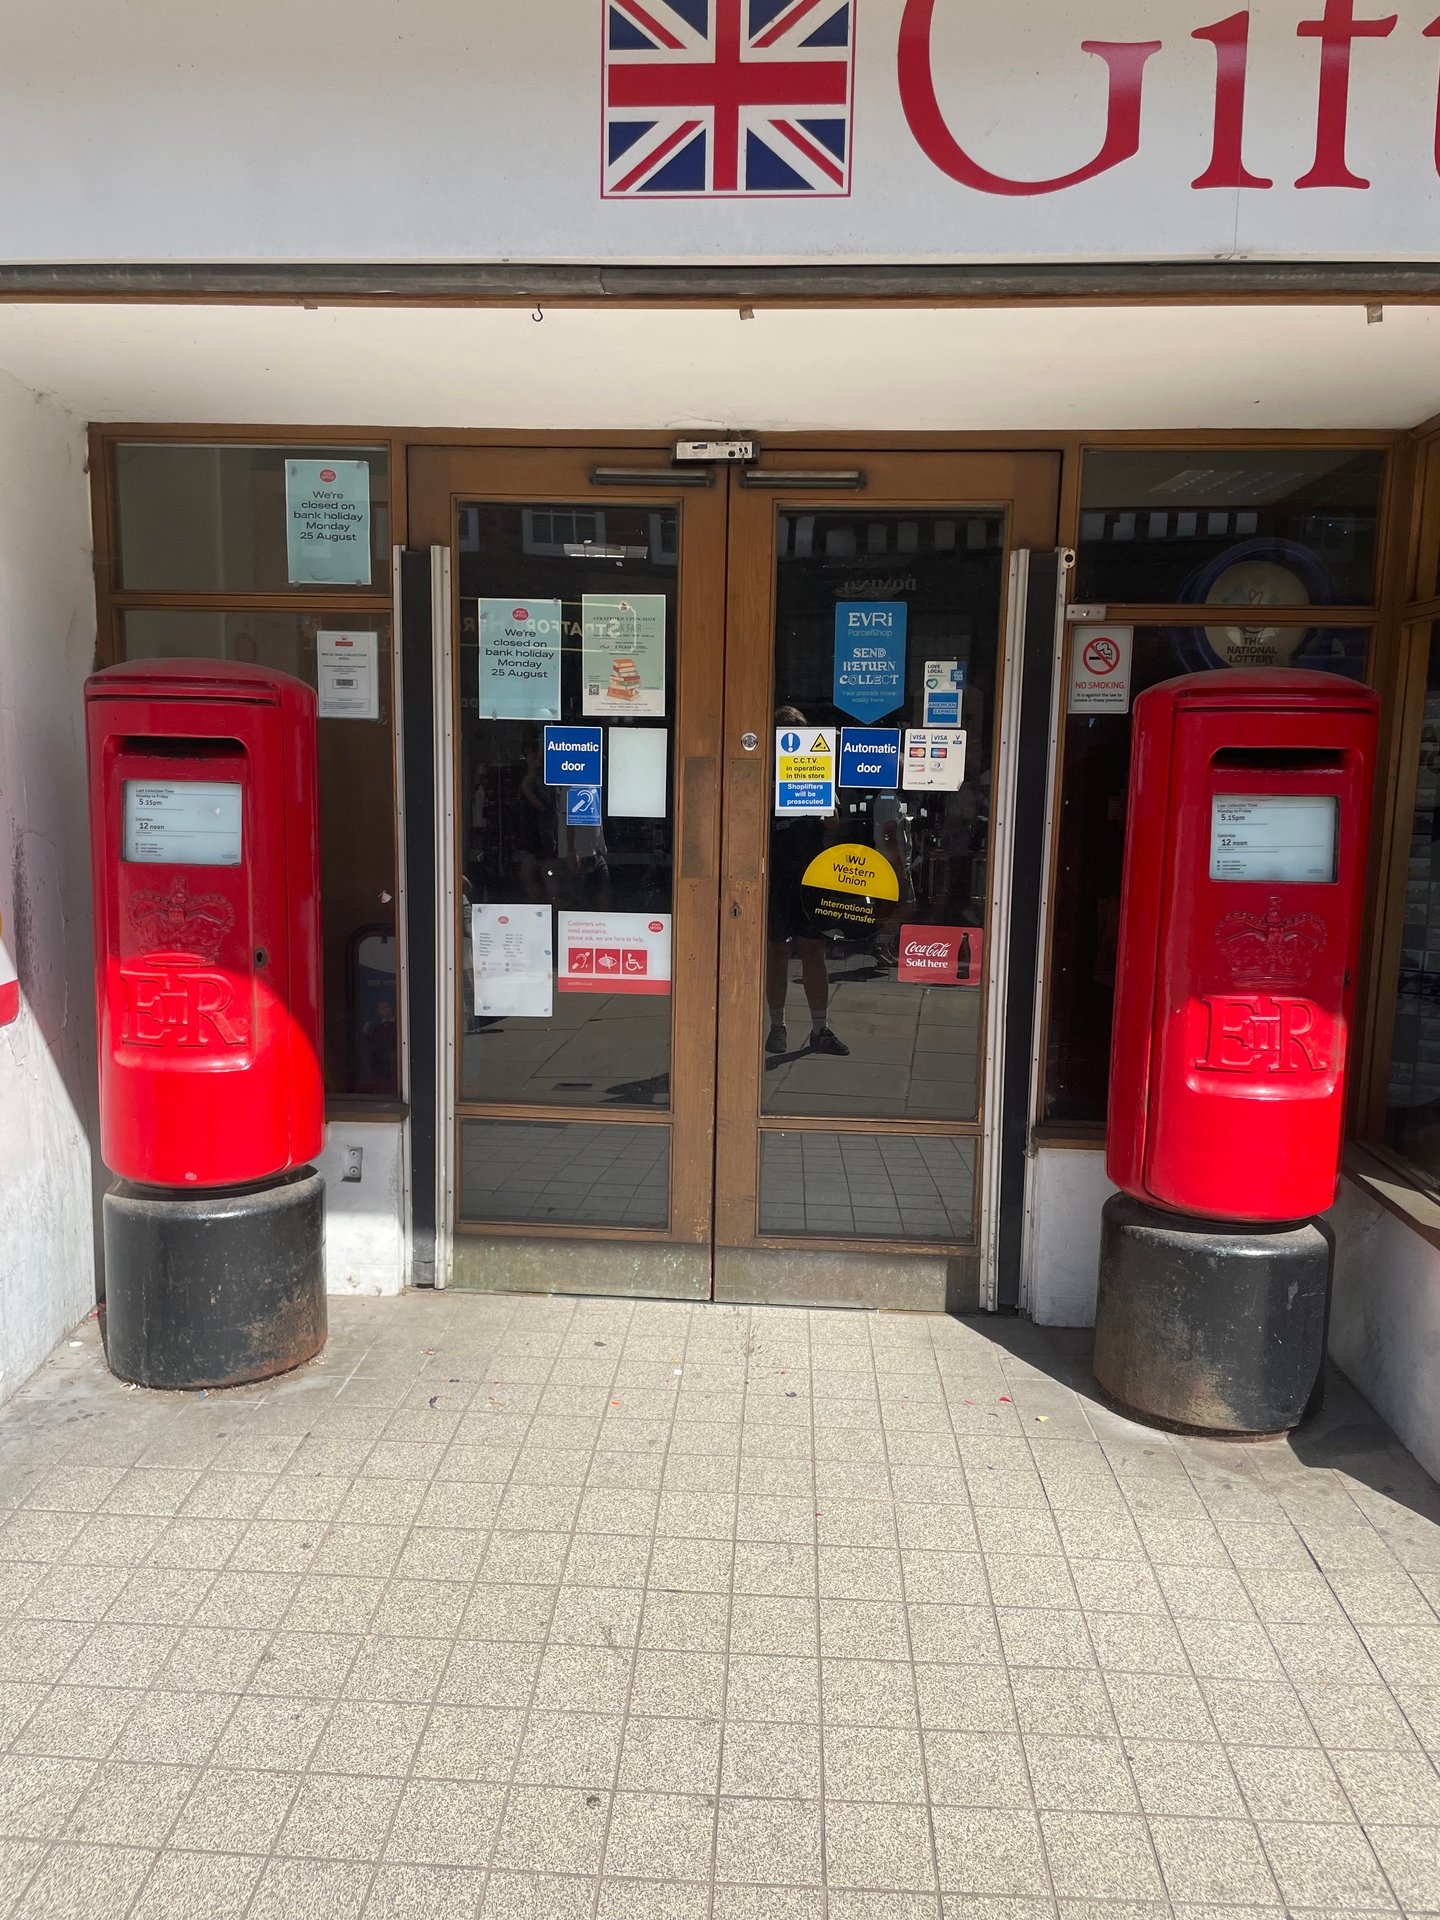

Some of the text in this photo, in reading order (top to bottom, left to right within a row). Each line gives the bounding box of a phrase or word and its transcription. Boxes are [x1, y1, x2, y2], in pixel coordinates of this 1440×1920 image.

[897, 0, 1440, 197] Gif
[312, 490, 344, 500] We're
[301, 501, 355, 510] closed on
[294, 511, 364, 522] bank holiday
[306, 522, 350, 532] Monday
[300, 532, 357, 542] 25 August
[504, 628, 536, 638] We're
[848, 629, 892, 638] ParcelShop
[493, 638, 532, 648] closed
[485, 648, 554, 660] bank holiday
[853, 648, 886, 658] SEND
[1227, 646, 1278, 654] NATIONAL
[497, 658, 542, 670] Monday
[1229, 655, 1274, 664] LOTTERY
[843, 661, 895, 671] RETURN
[507, 669, 548, 680] August
[839, 674, 899, 685] COLLECT
[548, 741, 599, 752] Automatic
[843, 742, 897, 754] Automatic
[561, 761, 585, 771] door
[857, 763, 882, 773] door
[846, 855, 866, 866] WU
[833, 863, 875, 879] Western
[838, 874, 867, 887] Union
[820, 898, 874, 914] International
[814, 907, 876, 924] money transfer
[904, 940, 952, 958] Coca-Cola
[906, 958, 948, 969] Sold here
